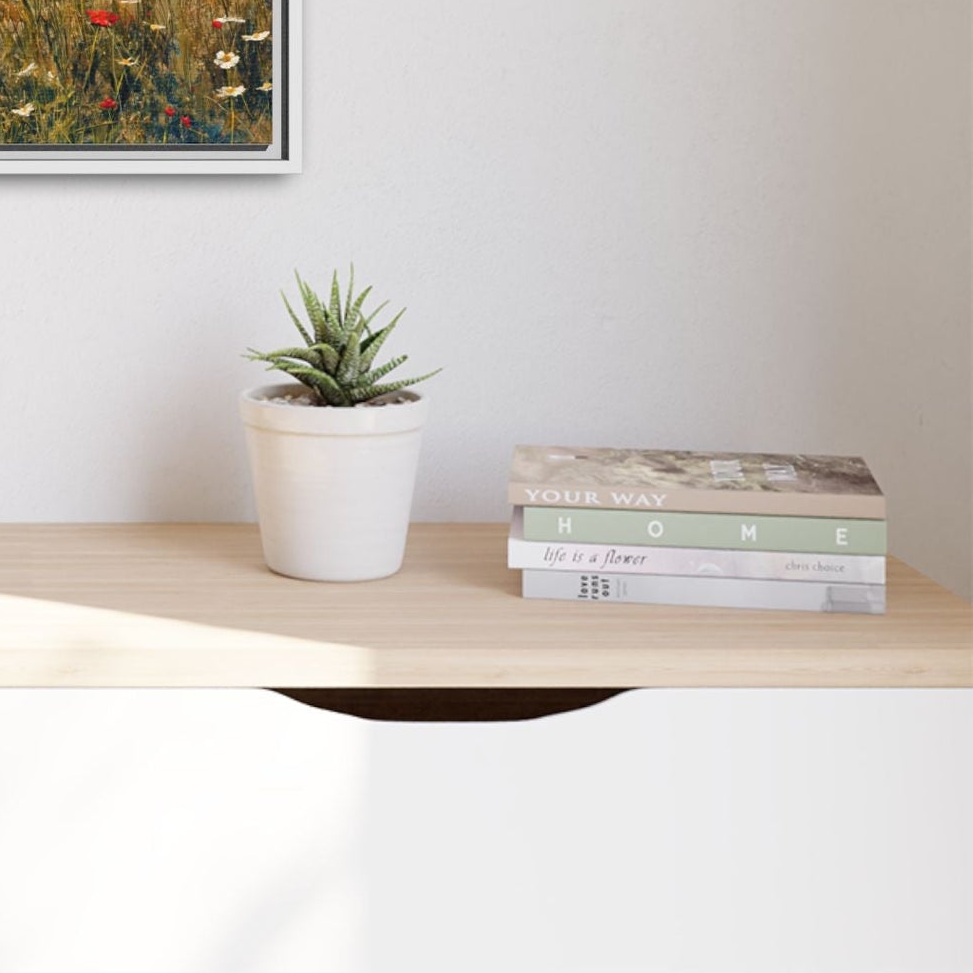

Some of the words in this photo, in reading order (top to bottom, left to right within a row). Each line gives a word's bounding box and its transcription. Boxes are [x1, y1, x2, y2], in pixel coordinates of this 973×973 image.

[525, 489, 601, 504] YOUR
[611, 492, 667, 506] WAY
[543, 547, 567, 566] life
[572, 549, 584, 563] is
[589, 554, 597, 563] a
[600, 549, 648, 569] flower
[785, 560, 809, 572] chris
[812, 560, 846, 573] choice
[577, 575, 589, 598] love
[591, 575, 599, 600] runs
[600, 579, 610, 597] out
